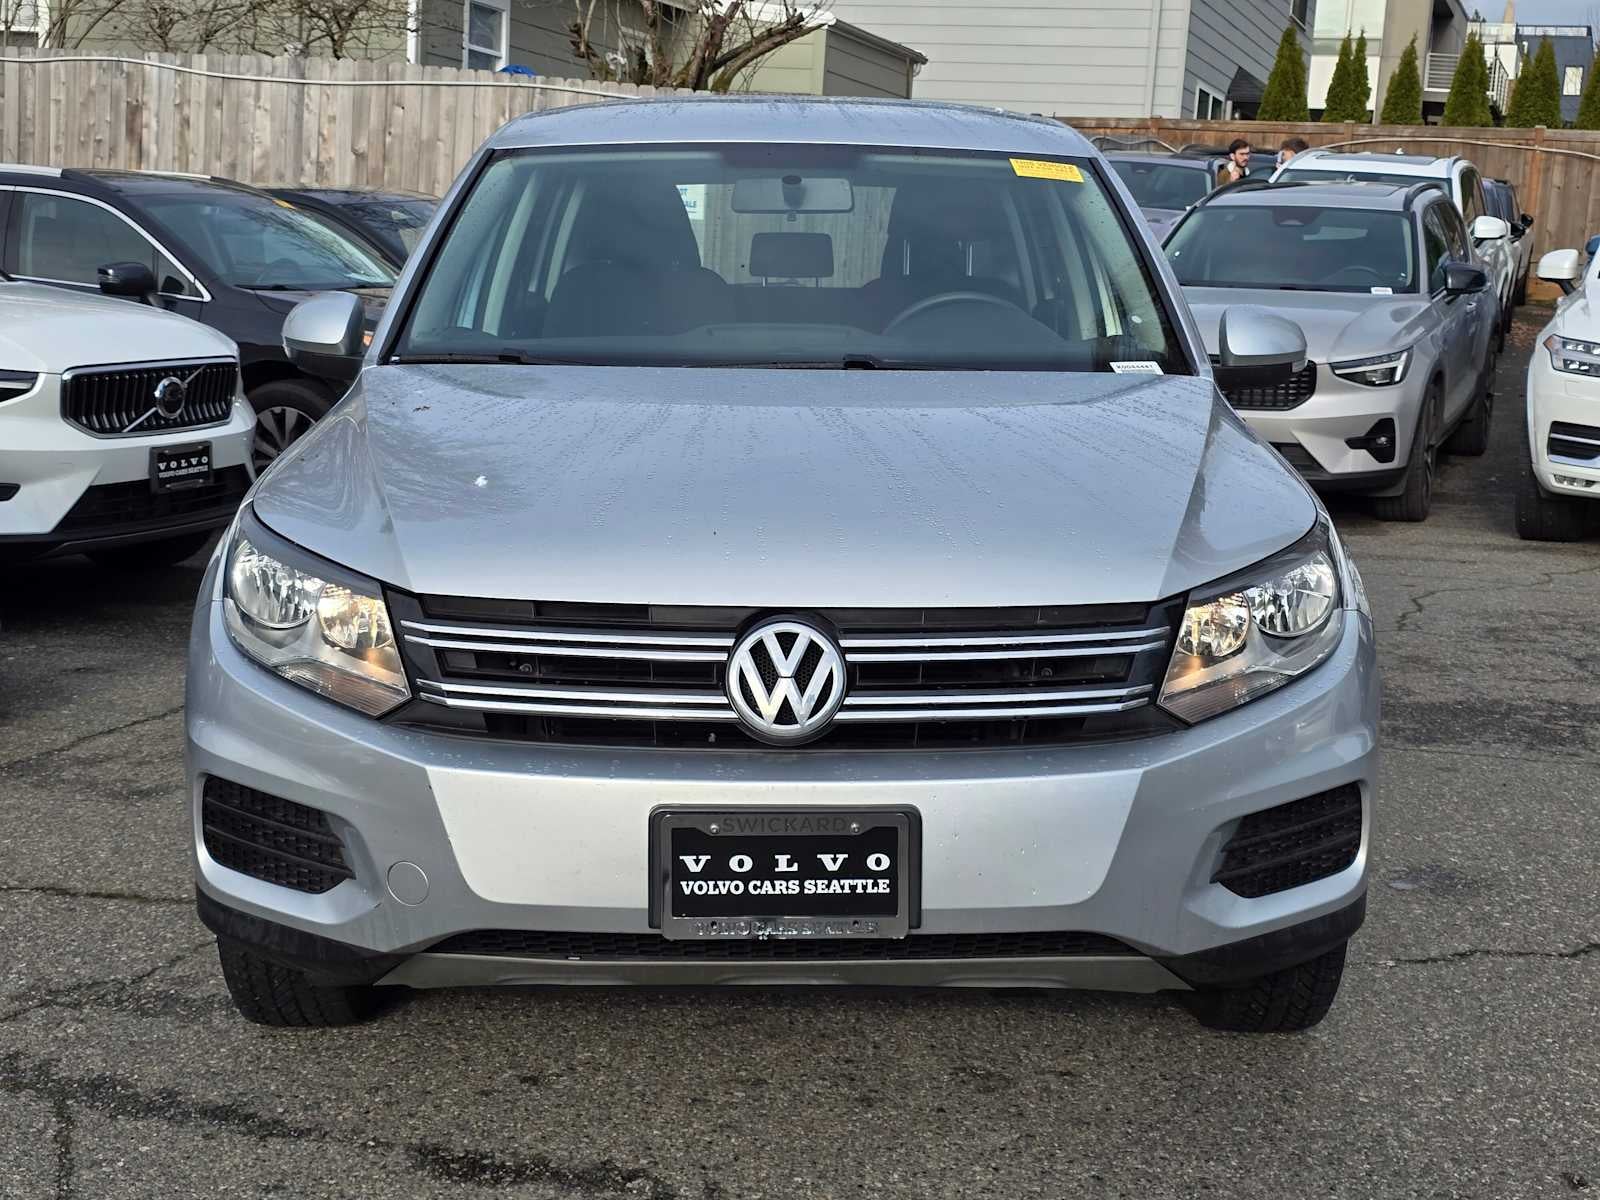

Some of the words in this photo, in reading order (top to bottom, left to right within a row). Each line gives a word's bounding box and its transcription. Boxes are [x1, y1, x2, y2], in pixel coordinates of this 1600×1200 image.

[158, 456, 209, 470] VOLVO
[721, 817, 848, 834] SWICKARD
[679, 853, 891, 873] VOLVO
[680, 880, 745, 895] VOLVO
[748, 879, 800, 895] CARS
[803, 879, 891, 894] SEATTLE
